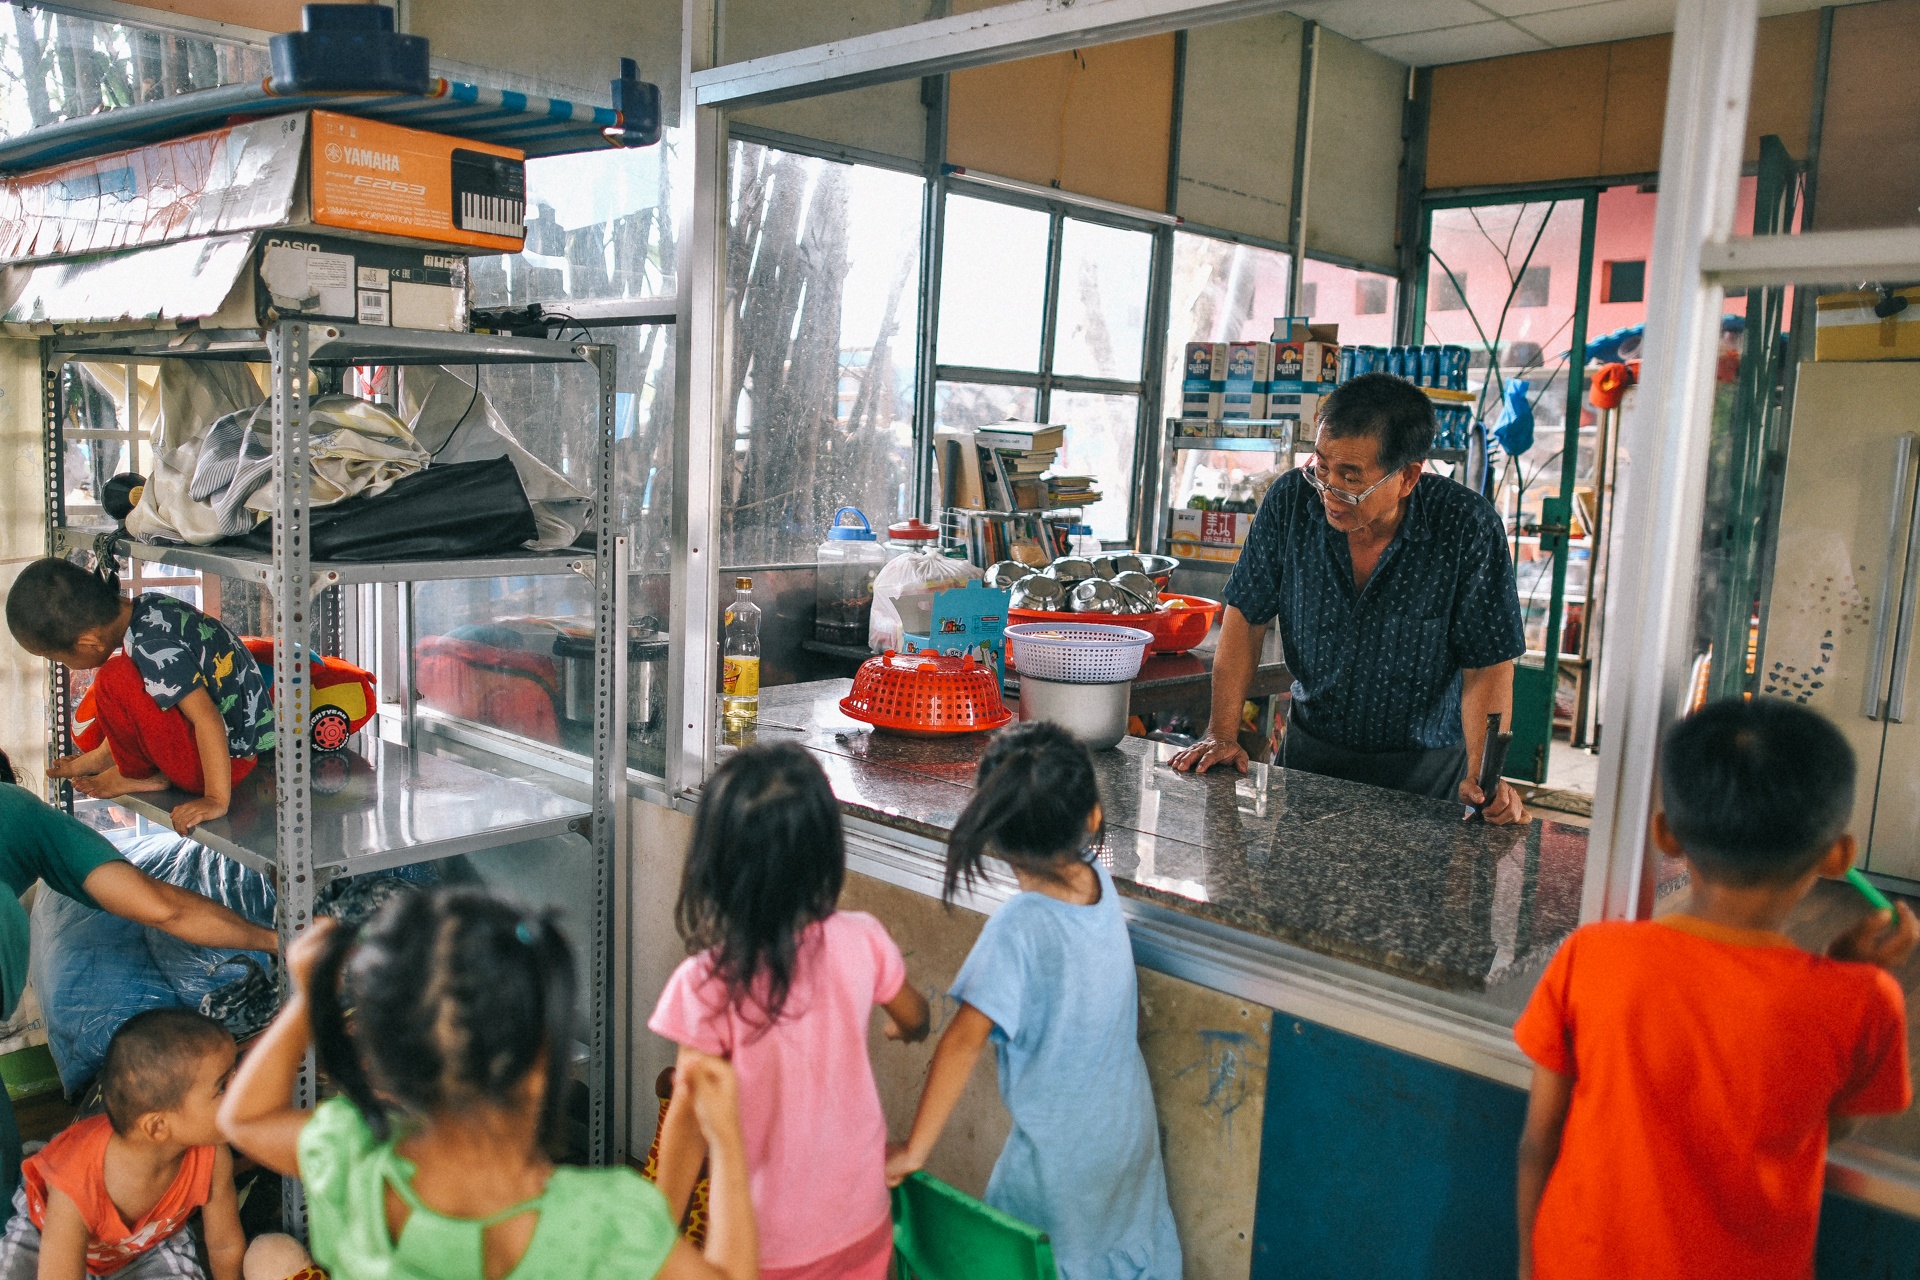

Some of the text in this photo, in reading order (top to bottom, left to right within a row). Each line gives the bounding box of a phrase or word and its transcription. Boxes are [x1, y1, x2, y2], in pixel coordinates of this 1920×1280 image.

[343, 145, 400, 173] YAMAHA
[354, 175, 426, 195] E263
[360, 210, 413, 225] CORPORATION
[268, 238, 321, 253] CASIO
[1276, 363, 1301, 371] QUAKER
[310, 709, 348, 728] IGHTYEAR
